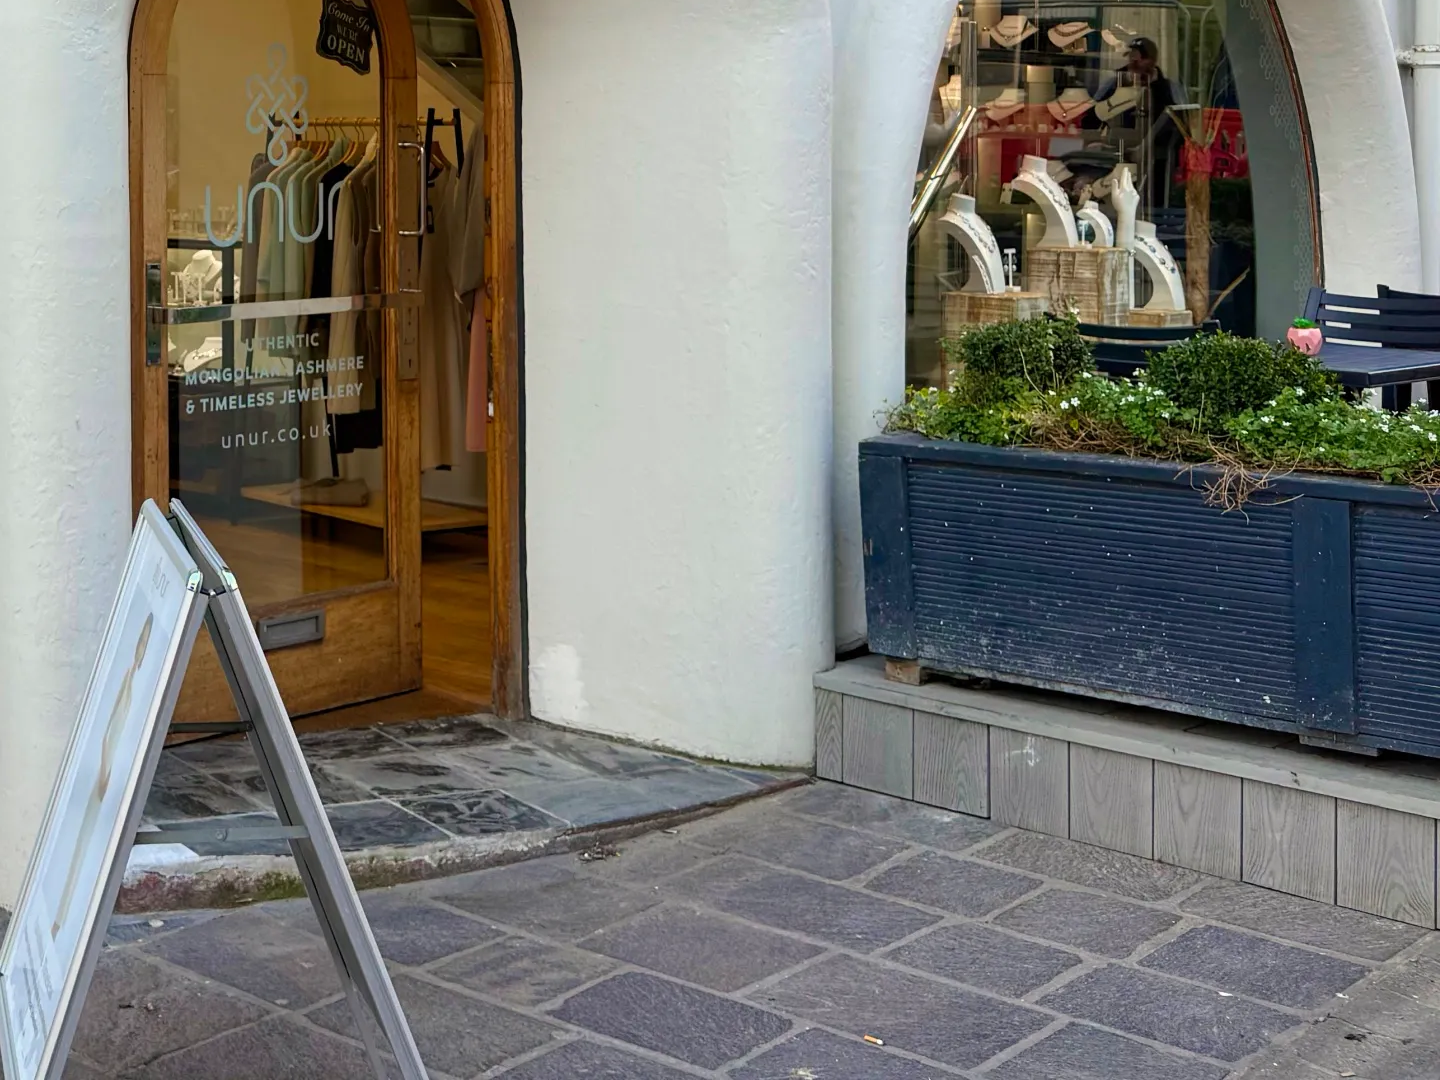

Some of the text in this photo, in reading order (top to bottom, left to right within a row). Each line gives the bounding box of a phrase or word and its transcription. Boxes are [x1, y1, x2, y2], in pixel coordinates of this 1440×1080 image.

[327, 1, 354, 24] Come
[327, 34, 365, 64] OPEN
[205, 181, 344, 248] unur
[245, 332, 320, 352] UTHENTIC
[185, 355, 364, 386] MONGOLIAN ASHMERE
[186, 383, 363, 414] & TIMELESS JEWELLERY
[221, 419, 331, 449] unur.co.uk
